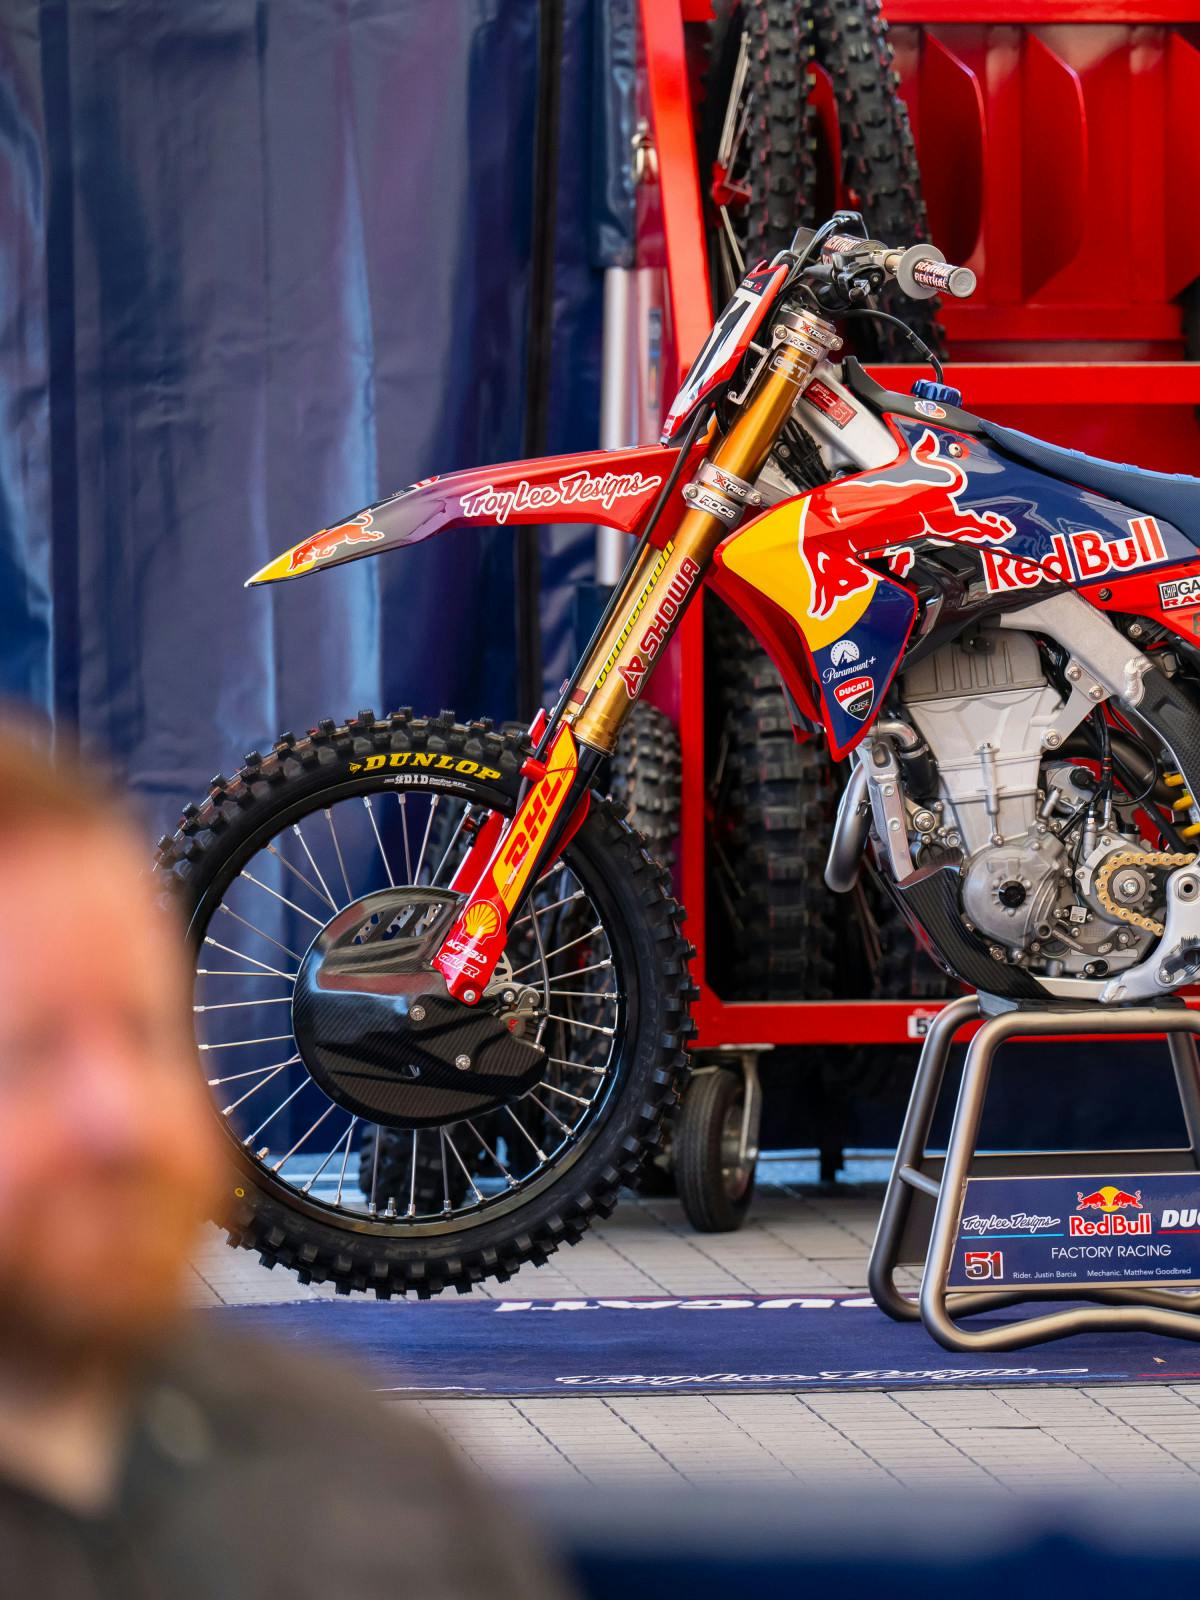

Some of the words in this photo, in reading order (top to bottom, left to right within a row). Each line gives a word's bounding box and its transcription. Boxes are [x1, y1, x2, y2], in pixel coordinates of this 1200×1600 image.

[713, 471, 748, 497] XTRIG
[460, 485, 514, 524] Troy
[513, 481, 560, 511] Lee
[559, 471, 662, 509] Designs
[699, 495, 737, 518] ROCS
[980, 533, 1077, 593] Red
[1069, 516, 1168, 580] Bull
[639, 555, 700, 661] SHOWA
[822, 656, 876, 684] Paramount+
[839, 681, 870, 697] DUCATI
[849, 699, 870, 713] CORSE
[363, 752, 502, 780] DUNLOP
[503, 776, 563, 868] DHL
[962, 1215, 988, 1235] Troy
[987, 1215, 1011, 1229] Lee
[1010, 1213, 1060, 1234] Designs
[1069, 1215, 1110, 1237] Red
[1109, 1213, 1151, 1236] Bull
[1051, 1246, 1114, 1259] FACTORY
[1117, 1244, 1172, 1257] RACING
[964, 1250, 1004, 1280] 51
[1034, 1271, 1055, 1279] Justin
[1056, 1270, 1077, 1278] Barcia
[1123, 1268, 1154, 1276] Matthew
[1155, 1267, 1192, 1275] Goodbred
[555, 1375, 700, 1386] Troy
[696, 1373, 820, 1382] Lee
[818, 1367, 1090, 1380] Designs
